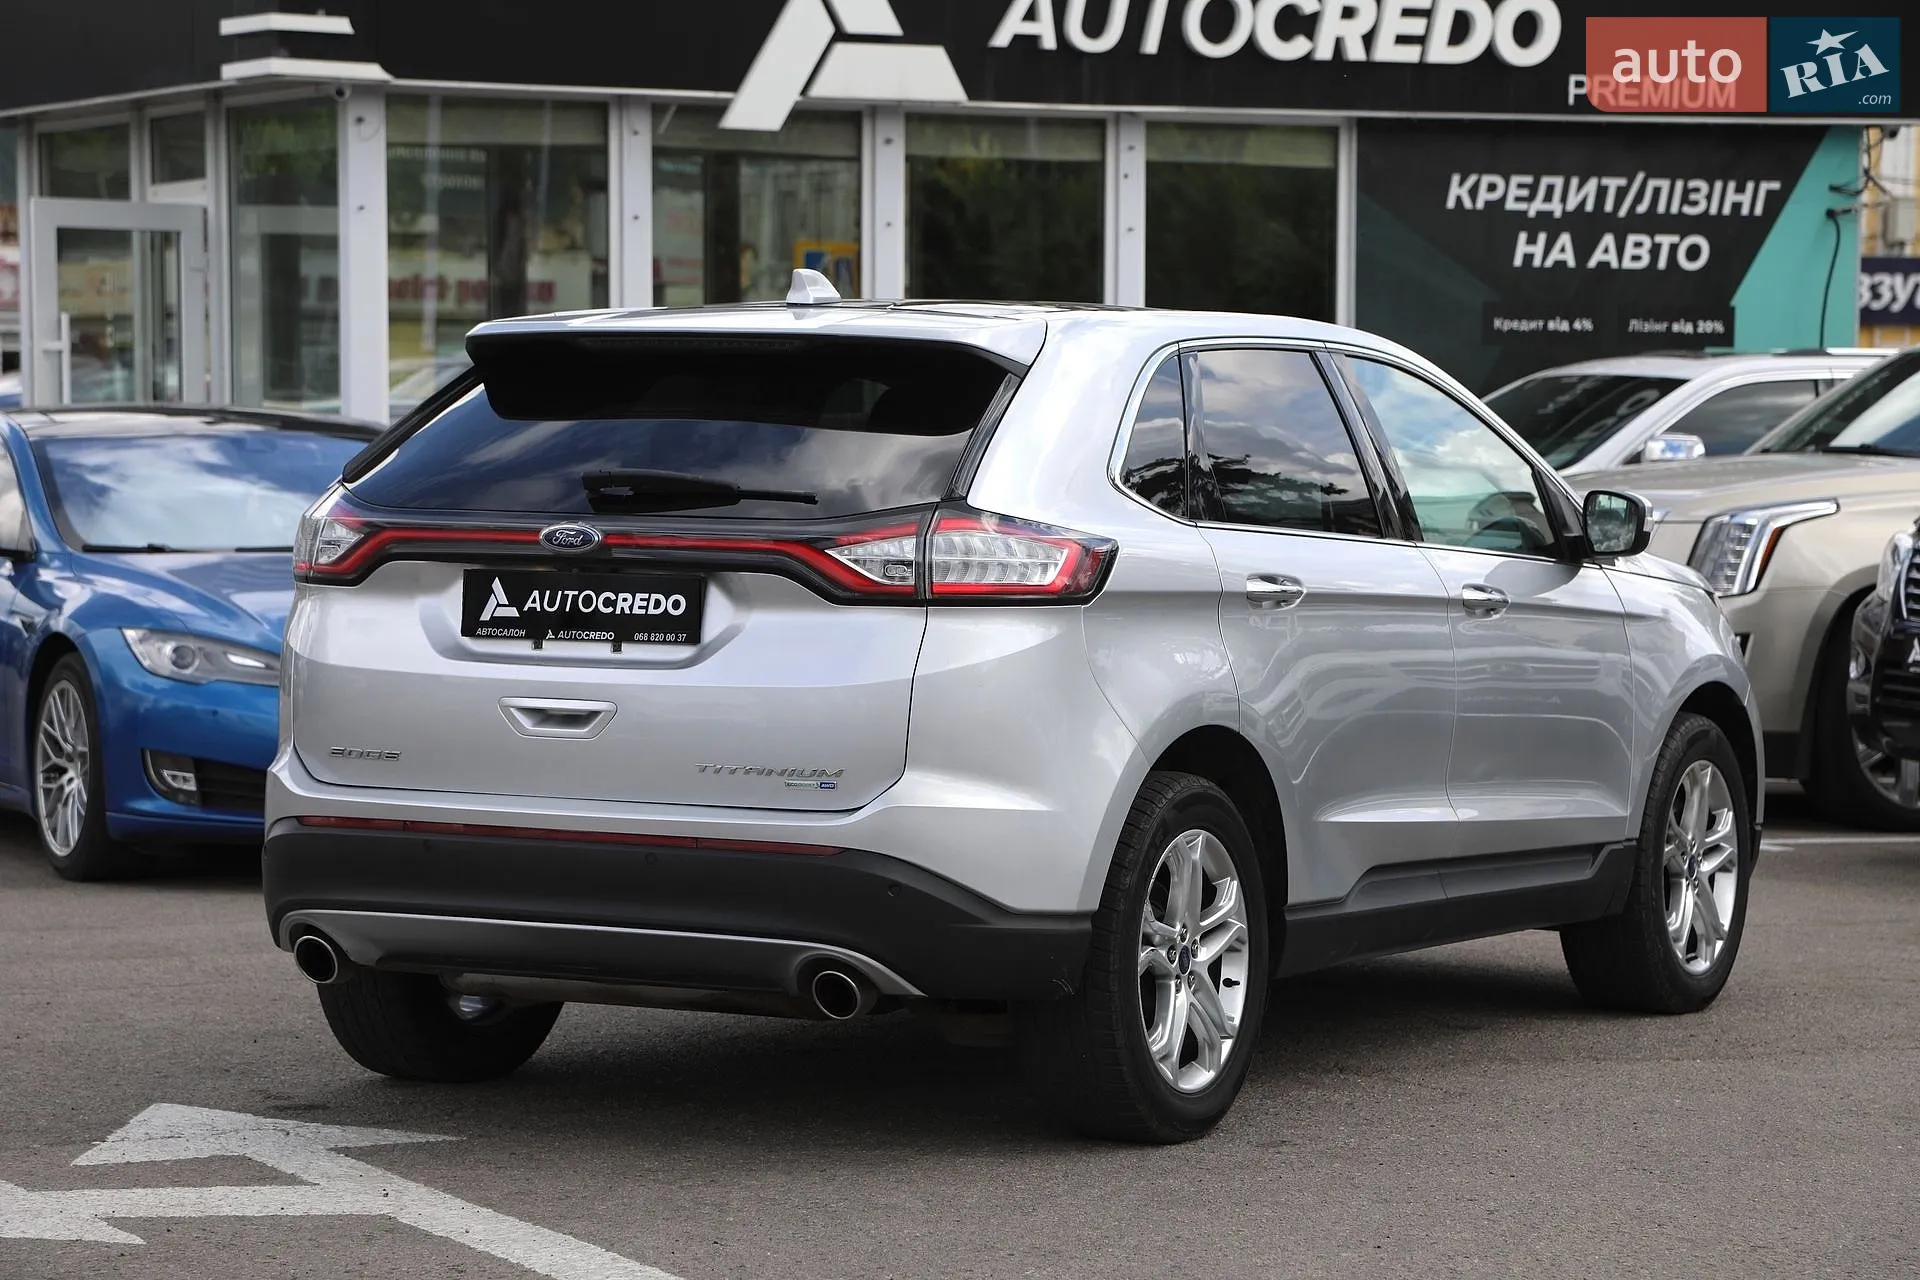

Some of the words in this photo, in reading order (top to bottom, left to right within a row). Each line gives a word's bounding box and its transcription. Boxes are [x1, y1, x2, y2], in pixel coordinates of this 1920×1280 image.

[988, 0, 1562, 67] AUTOCREDO
[1568, 73, 1737, 108] PREMIUM
[1446, 171, 1781, 218] КРЕДИТ/ЛІЗІНГ
[1513, 230, 1577, 269] НА
[1587, 233, 1711, 271] АВТО
[1493, 317, 1545, 332] Кредит
[1572, 318, 1594, 332] 4%
[1628, 318, 1669, 333] Лізінг
[552, 529, 583, 546] Ford
[523, 590, 687, 616] AUTOCREDO
[476, 627, 526, 638] АВТОСАЛОН
[557, 631, 615, 640] AUTOCREDO
[634, 632, 649, 642] 068
[650, 633, 664, 642] 820
[665, 633, 675, 642] 00
[677, 634, 687, 643] 37
[330, 746, 401, 761] EDGE
[695, 763, 845, 779] TITANIUM
